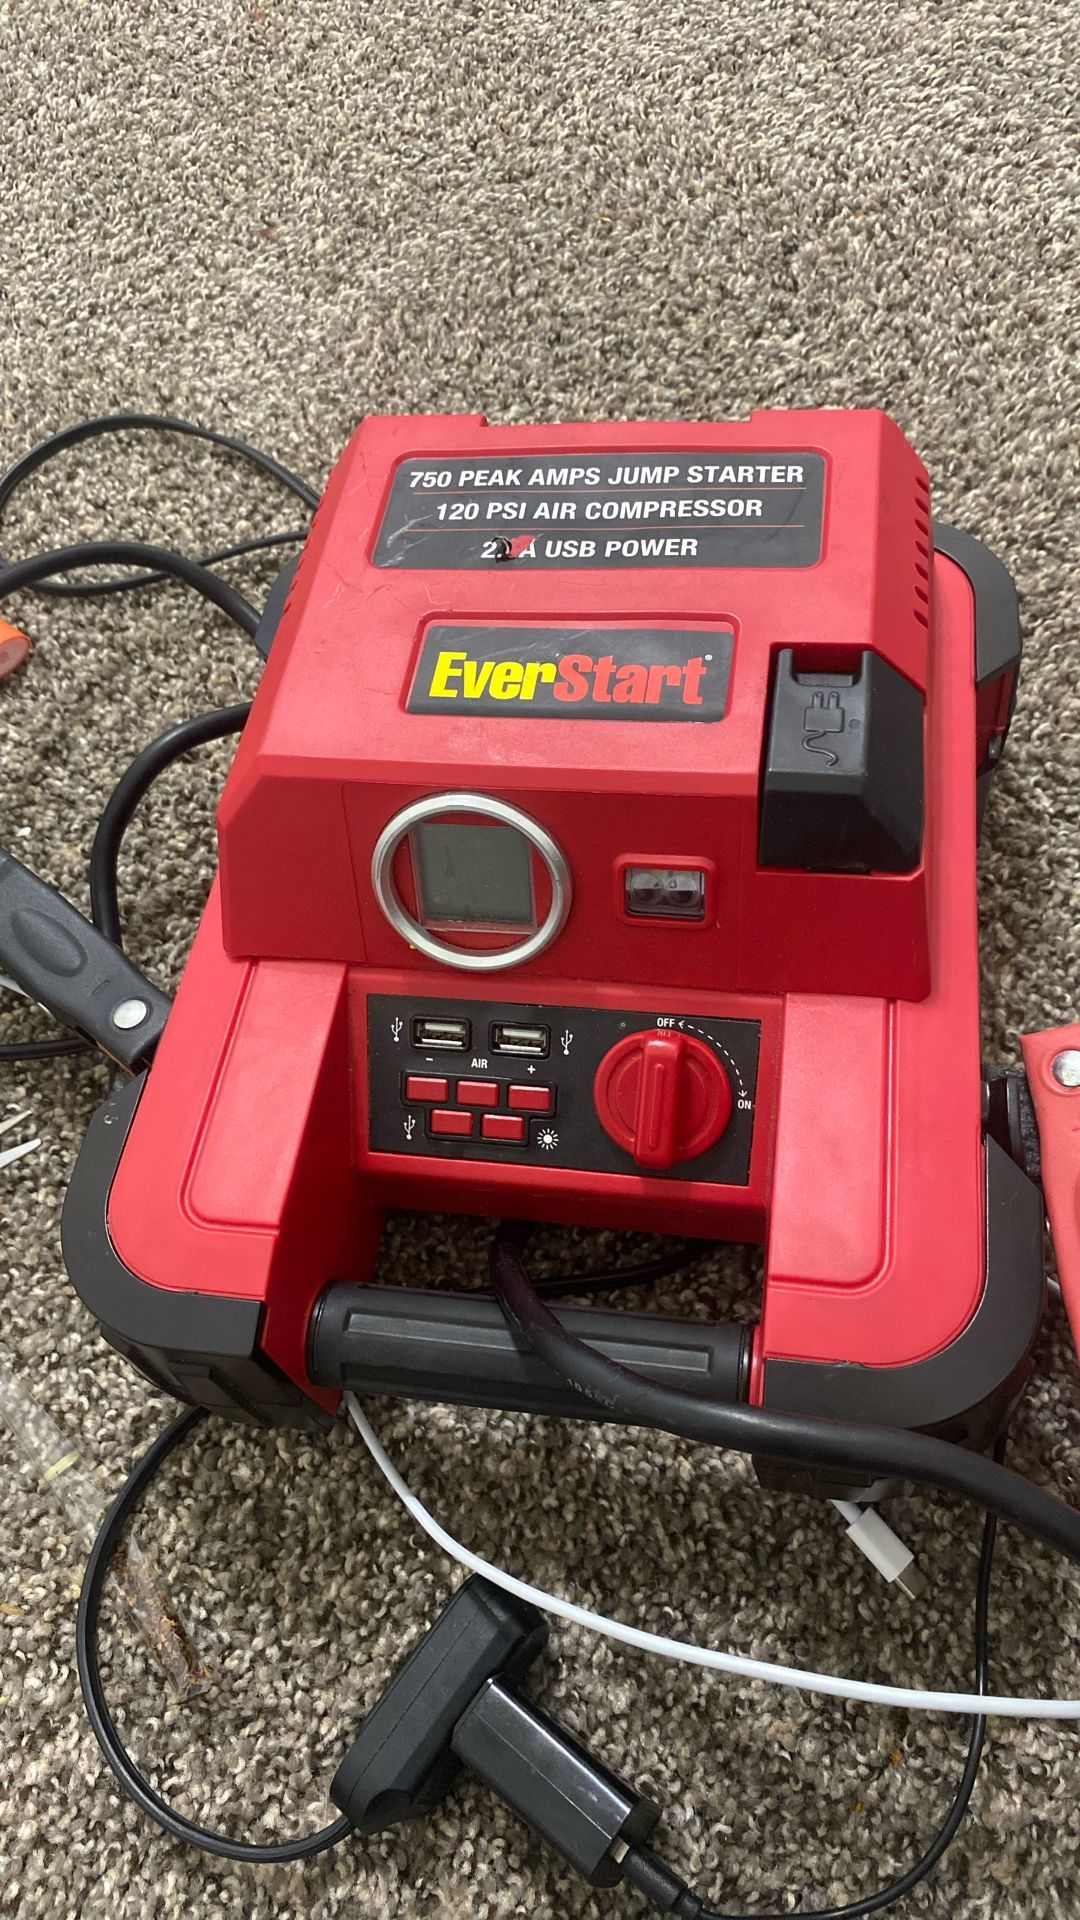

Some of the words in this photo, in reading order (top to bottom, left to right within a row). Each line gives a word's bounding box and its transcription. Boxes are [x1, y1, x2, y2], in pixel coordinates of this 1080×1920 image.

[409, 470, 453, 489] 750
[458, 468, 523, 488] PEAK
[527, 467, 601, 487] AMPS
[607, 465, 680, 486] JUMP
[686, 464, 804, 485] STARTER
[436, 502, 480, 521] 120
[485, 501, 527, 520] PSI
[532, 501, 577, 520] AIR
[584, 498, 763, 520] COMPRESSOR
[480, 537, 537, 559] 2.A
[544, 539, 597, 559] USB
[604, 538, 699, 558] POWER
[428, 651, 707, 705] EverStart
[656, 1016, 676, 1029] OFF
[470, 1057, 489, 1069] AIR
[737, 1099, 753, 1110] ON
